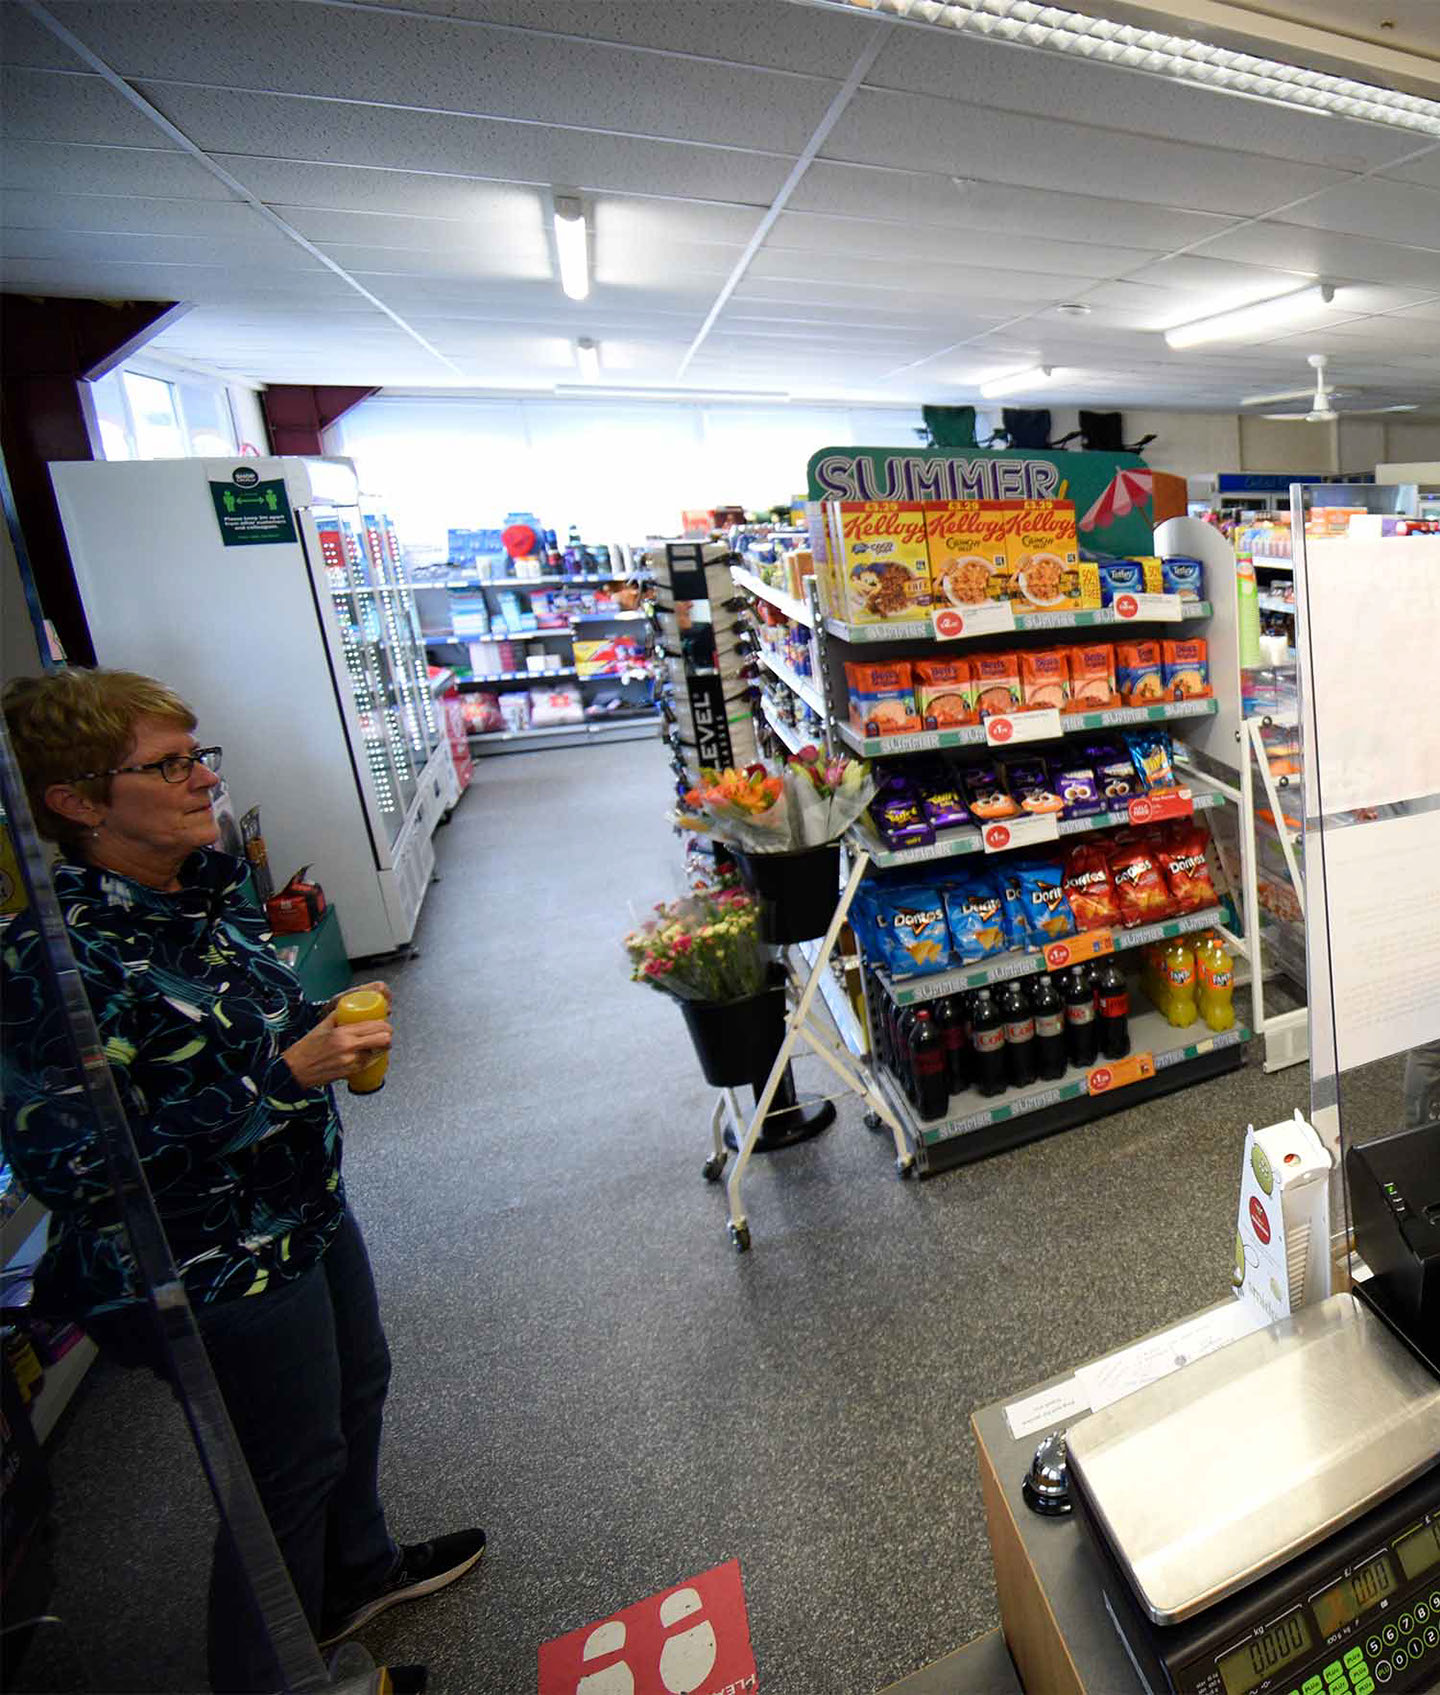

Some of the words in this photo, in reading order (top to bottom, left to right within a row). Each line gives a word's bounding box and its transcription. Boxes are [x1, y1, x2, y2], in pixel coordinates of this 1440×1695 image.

[814, 456, 1060, 501] SUMMER
[1169, 853, 1206, 874] Doritos
[1115, 859, 1152, 885] Doritos
[1032, 886, 1062, 904] Dorit
[962, 897, 1001, 914] Dorito
[894, 909, 944, 927] Doritos
[1433, 1597, 1440, 1607] 9
[1418, 1608, 1426, 1618] 8
[1402, 1619, 1409, 1629] 7
[1253, 1625, 1265, 1637] kg
[1386, 1630, 1394, 1640] 6
[1427, 1632, 1435, 1642] 2
[1370, 1641, 1378, 1652] 5
[1413, 1643, 1418, 1652] 1
[1396, 1655, 1404, 1665] 0
